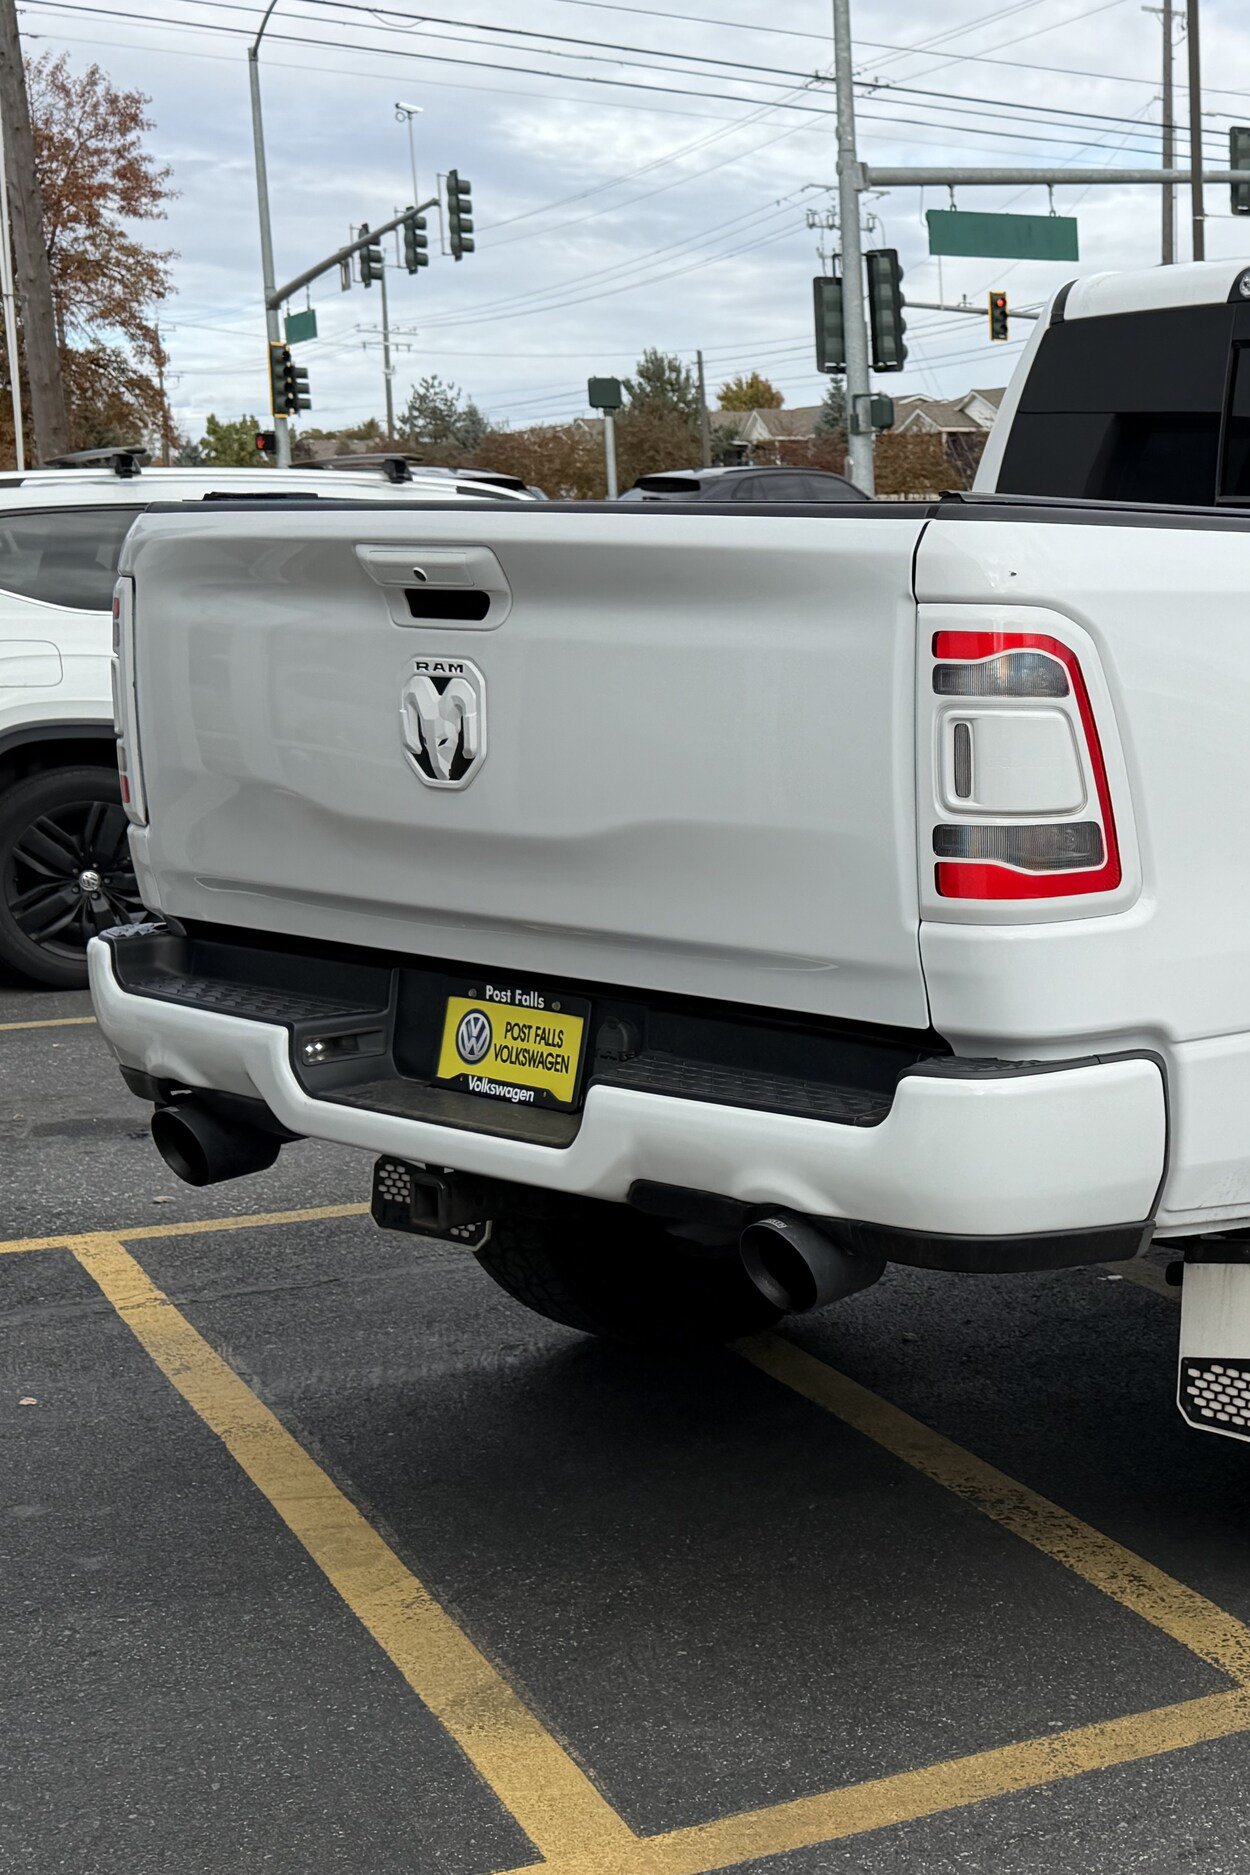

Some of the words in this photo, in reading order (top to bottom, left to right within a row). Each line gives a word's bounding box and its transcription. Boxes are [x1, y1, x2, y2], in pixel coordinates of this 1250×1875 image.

[415, 661, 464, 673] RAM
[485, 985, 511, 1003] Post
[515, 990, 545, 1008] Falls
[504, 1021, 533, 1043] POST
[534, 1026, 564, 1049] FALLS
[494, 1043, 571, 1074] VOLKSWAGEN
[468, 1075, 534, 1102] Volkswagen
